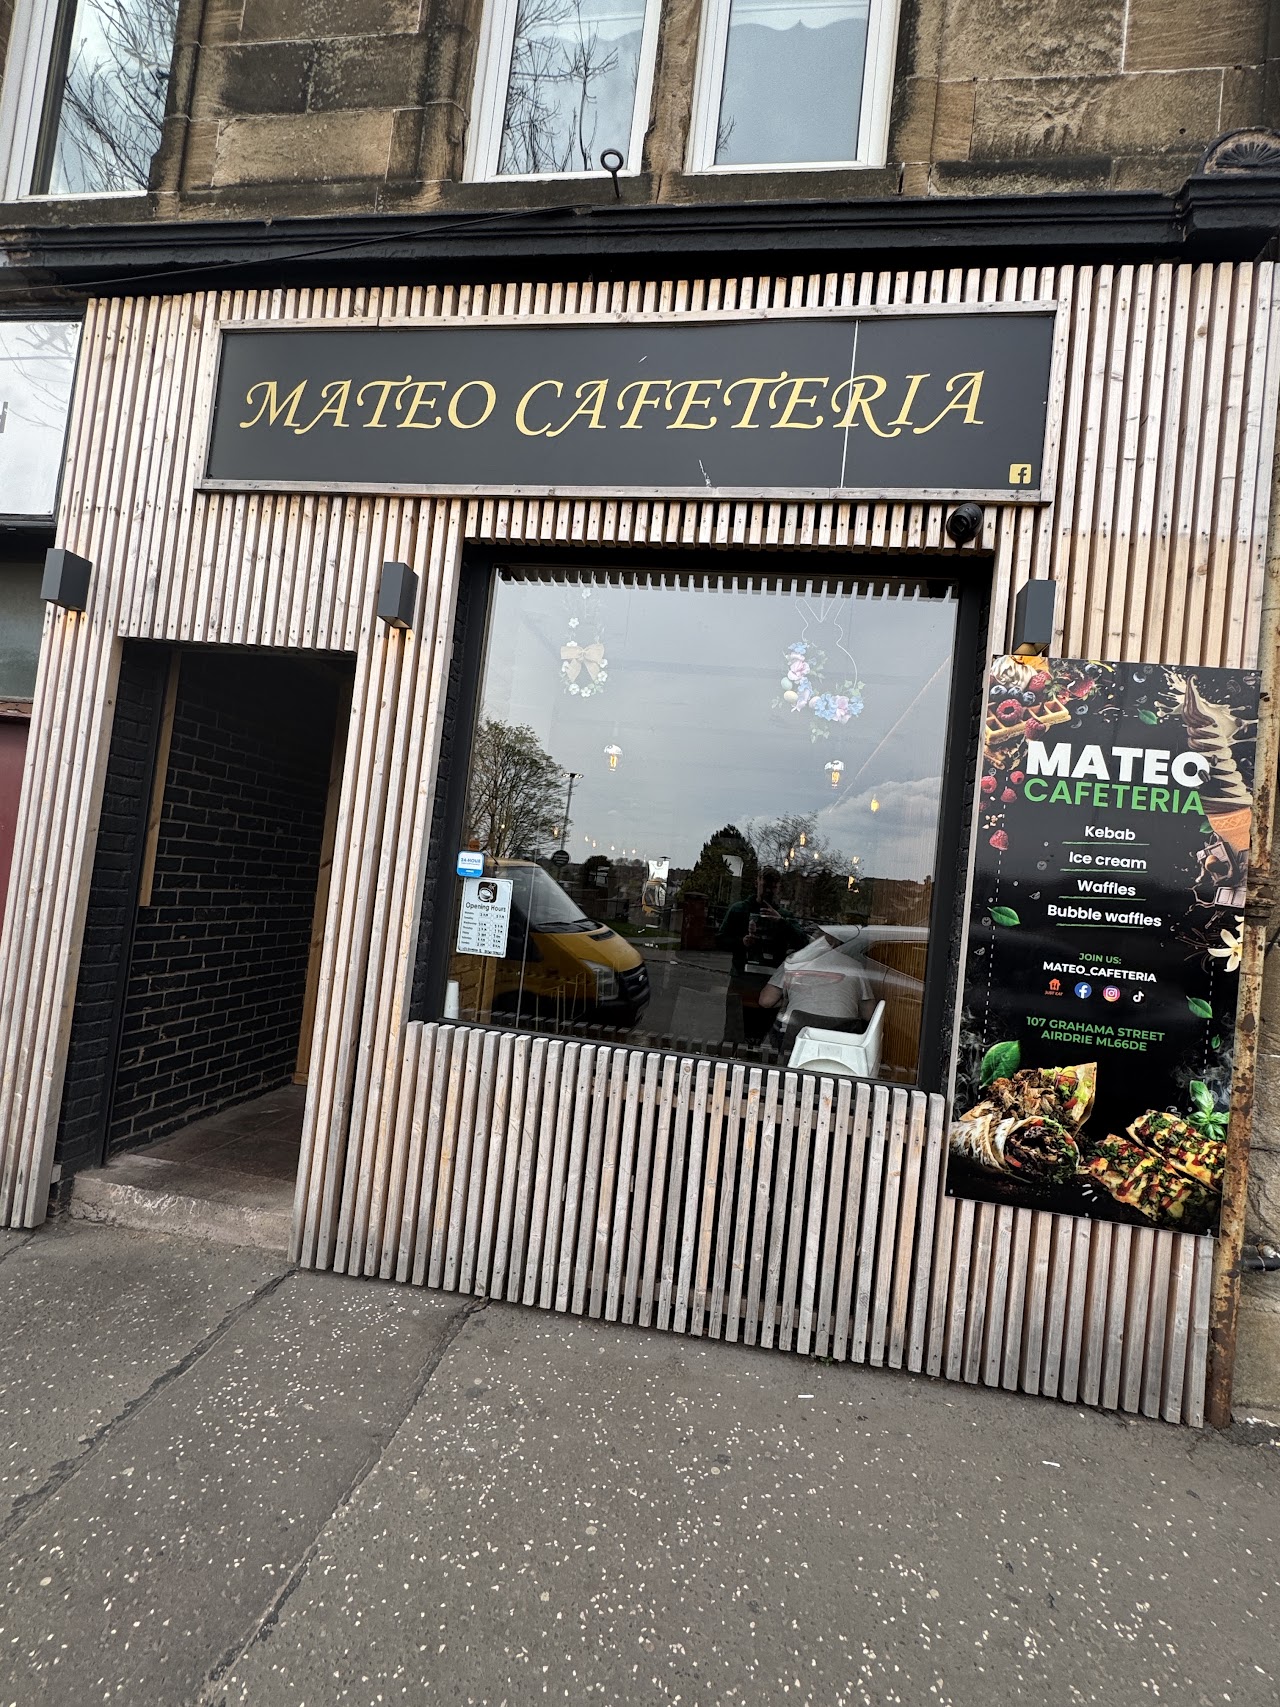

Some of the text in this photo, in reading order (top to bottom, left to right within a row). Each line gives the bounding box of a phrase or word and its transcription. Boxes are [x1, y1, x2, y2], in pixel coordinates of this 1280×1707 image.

[239, 369, 985, 438] MATEO CAFETERIA
[1026, 741, 1210, 787] MATEO
[1024, 778, 1205, 815] CAFETERIA
[1084, 825, 1136, 841] Kebab
[1068, 851, 1147, 870] Ice cream
[1077, 879, 1136, 897] Waffles
[465, 901, 506, 913] Opening Hours
[1047, 904, 1162, 927] Bubble waffles
[1078, 952, 1122, 965] JOIN US:
[1042, 961, 1157, 983] MATEO_CAFETERIA
[1026, 1016, 1165, 1042] 107 GRAHAMA STREET
[1041, 1029, 1148, 1051] AIRDRIE ML66DE
